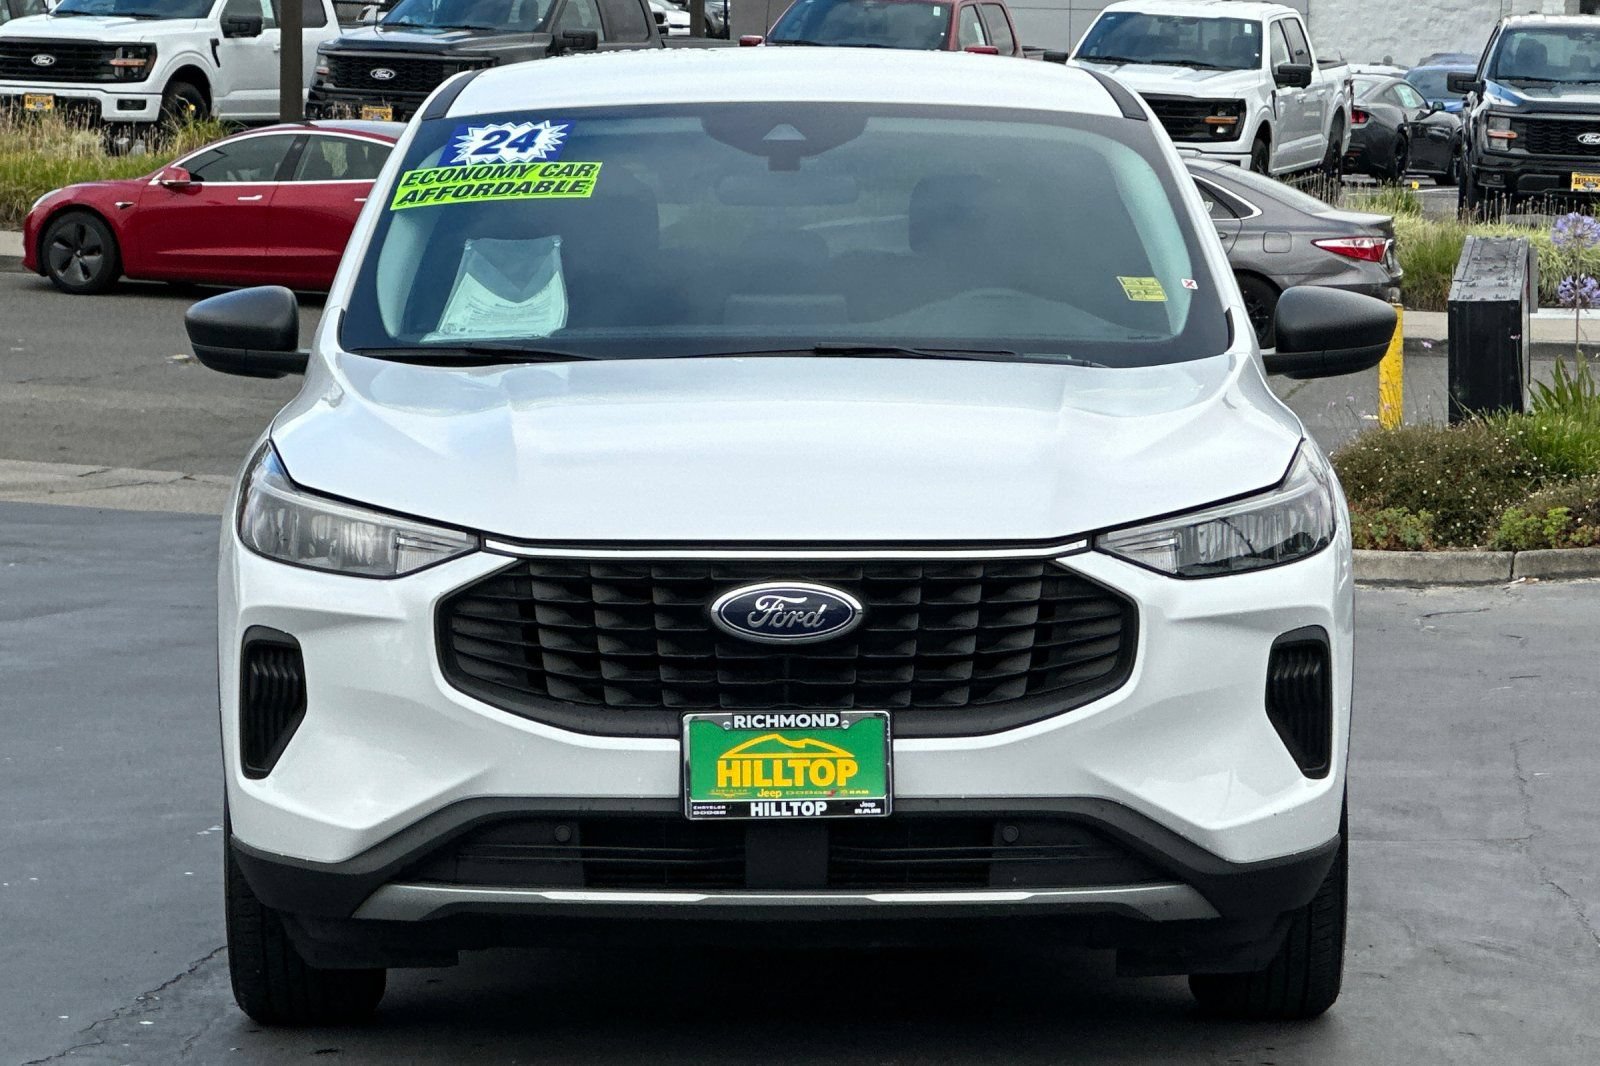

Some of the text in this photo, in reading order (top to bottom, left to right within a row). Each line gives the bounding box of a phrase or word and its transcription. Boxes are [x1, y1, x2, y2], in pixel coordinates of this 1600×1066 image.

[470, 128, 543, 156] 24
[402, 163, 598, 187] ECONOMY CAR
[396, 179, 594, 206] AFFORDABLE
[747, 595, 827, 628] Ford
[733, 713, 840, 729] RICHMOND
[717, 758, 859, 787] HILLTOP
[757, 788, 782, 799] Jeep
[750, 801, 828, 816] HILLTOP
